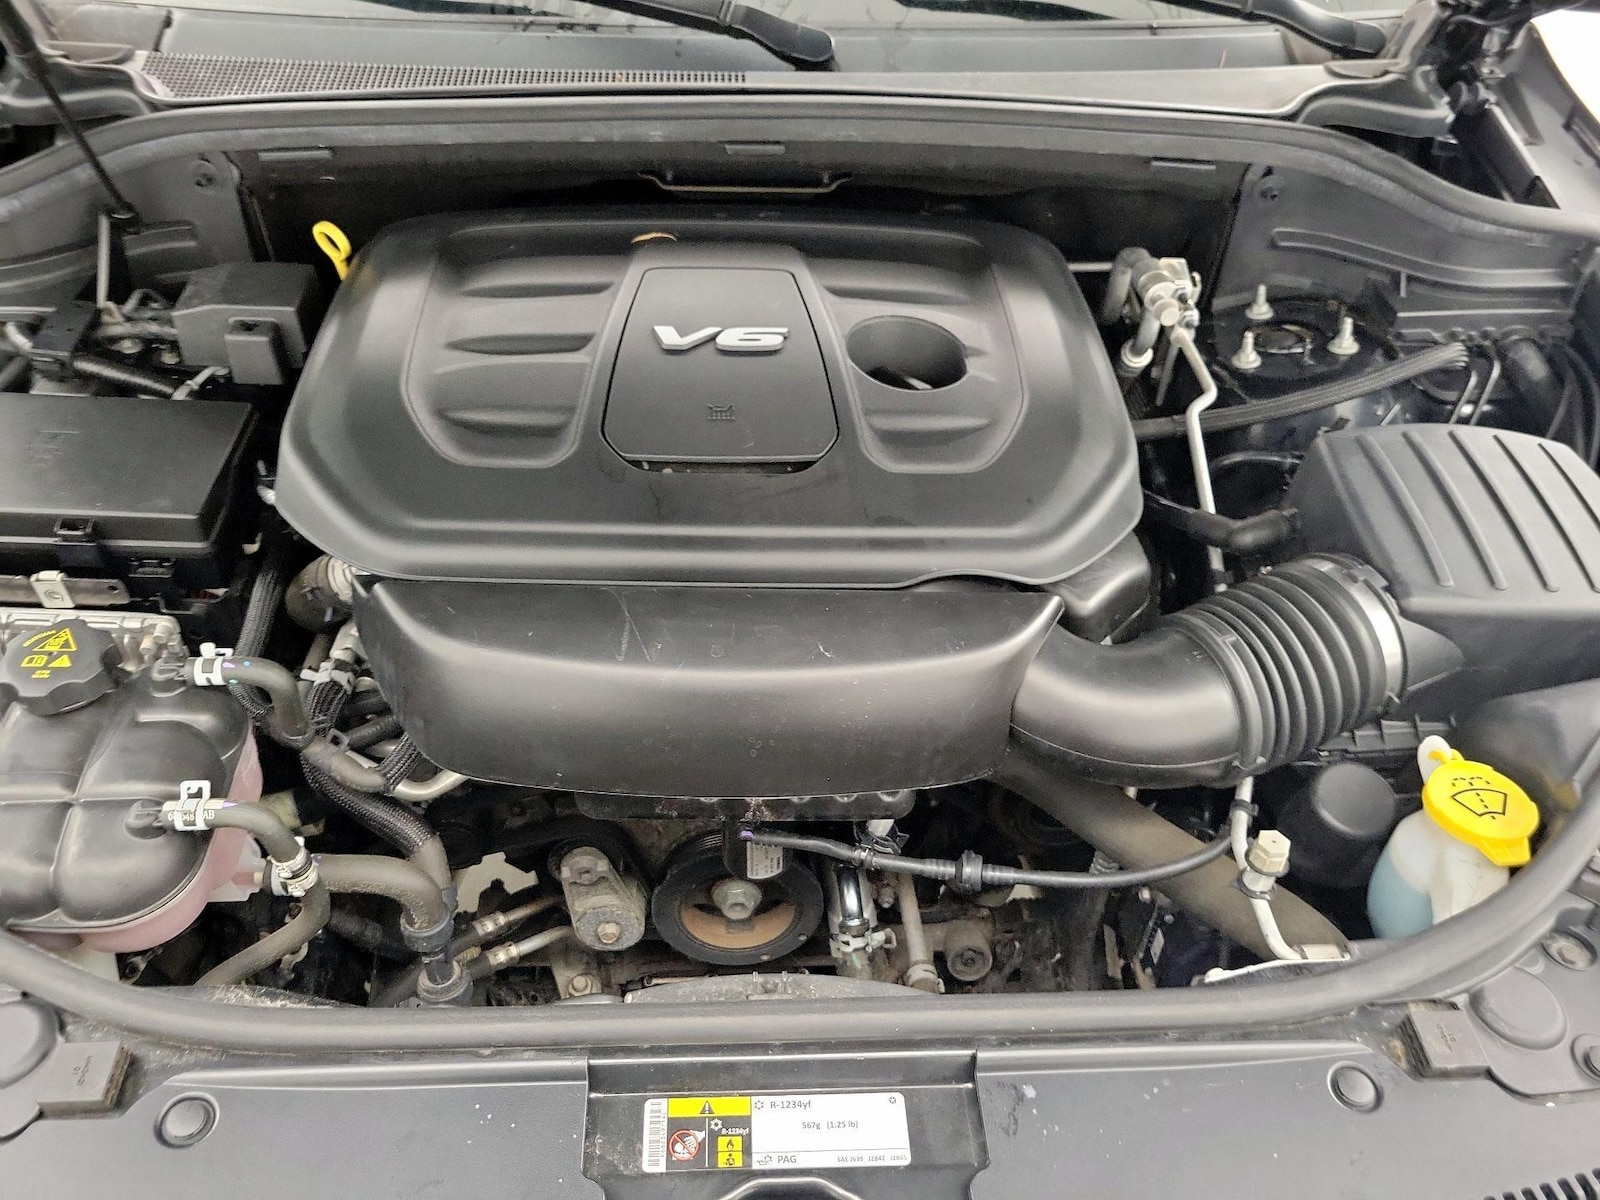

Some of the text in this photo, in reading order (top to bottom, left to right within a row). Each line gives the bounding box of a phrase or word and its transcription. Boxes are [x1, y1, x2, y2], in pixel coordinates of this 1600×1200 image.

[653, 325, 789, 352] V6
[770, 1100, 812, 1110] R-1234yf
[802, 1120, 859, 1130] 567g (1.25 lb)
[777, 1155, 797, 1164] PAG
